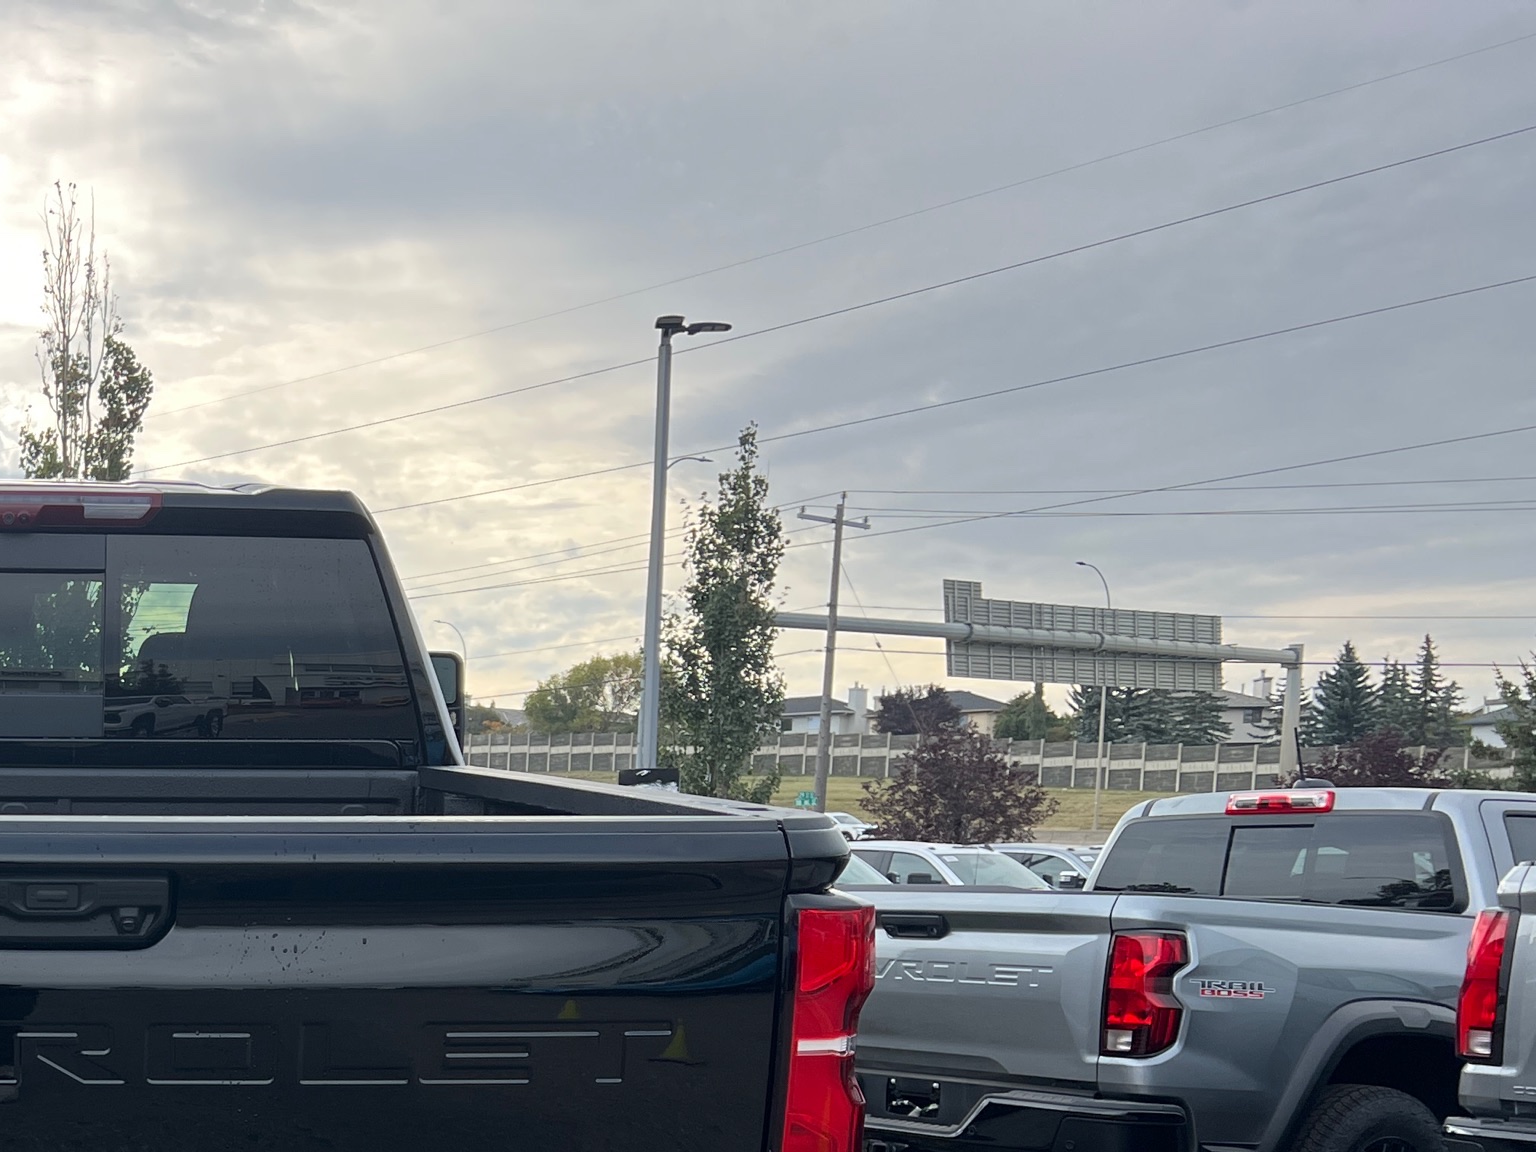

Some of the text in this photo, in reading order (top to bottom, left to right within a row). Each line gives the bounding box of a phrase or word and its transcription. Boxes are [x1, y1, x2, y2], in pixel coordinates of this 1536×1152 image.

[875, 958, 1054, 988] VROLET
[1189, 979, 1276, 993] TRAIL
[1200, 988, 1264, 999] BOSS
